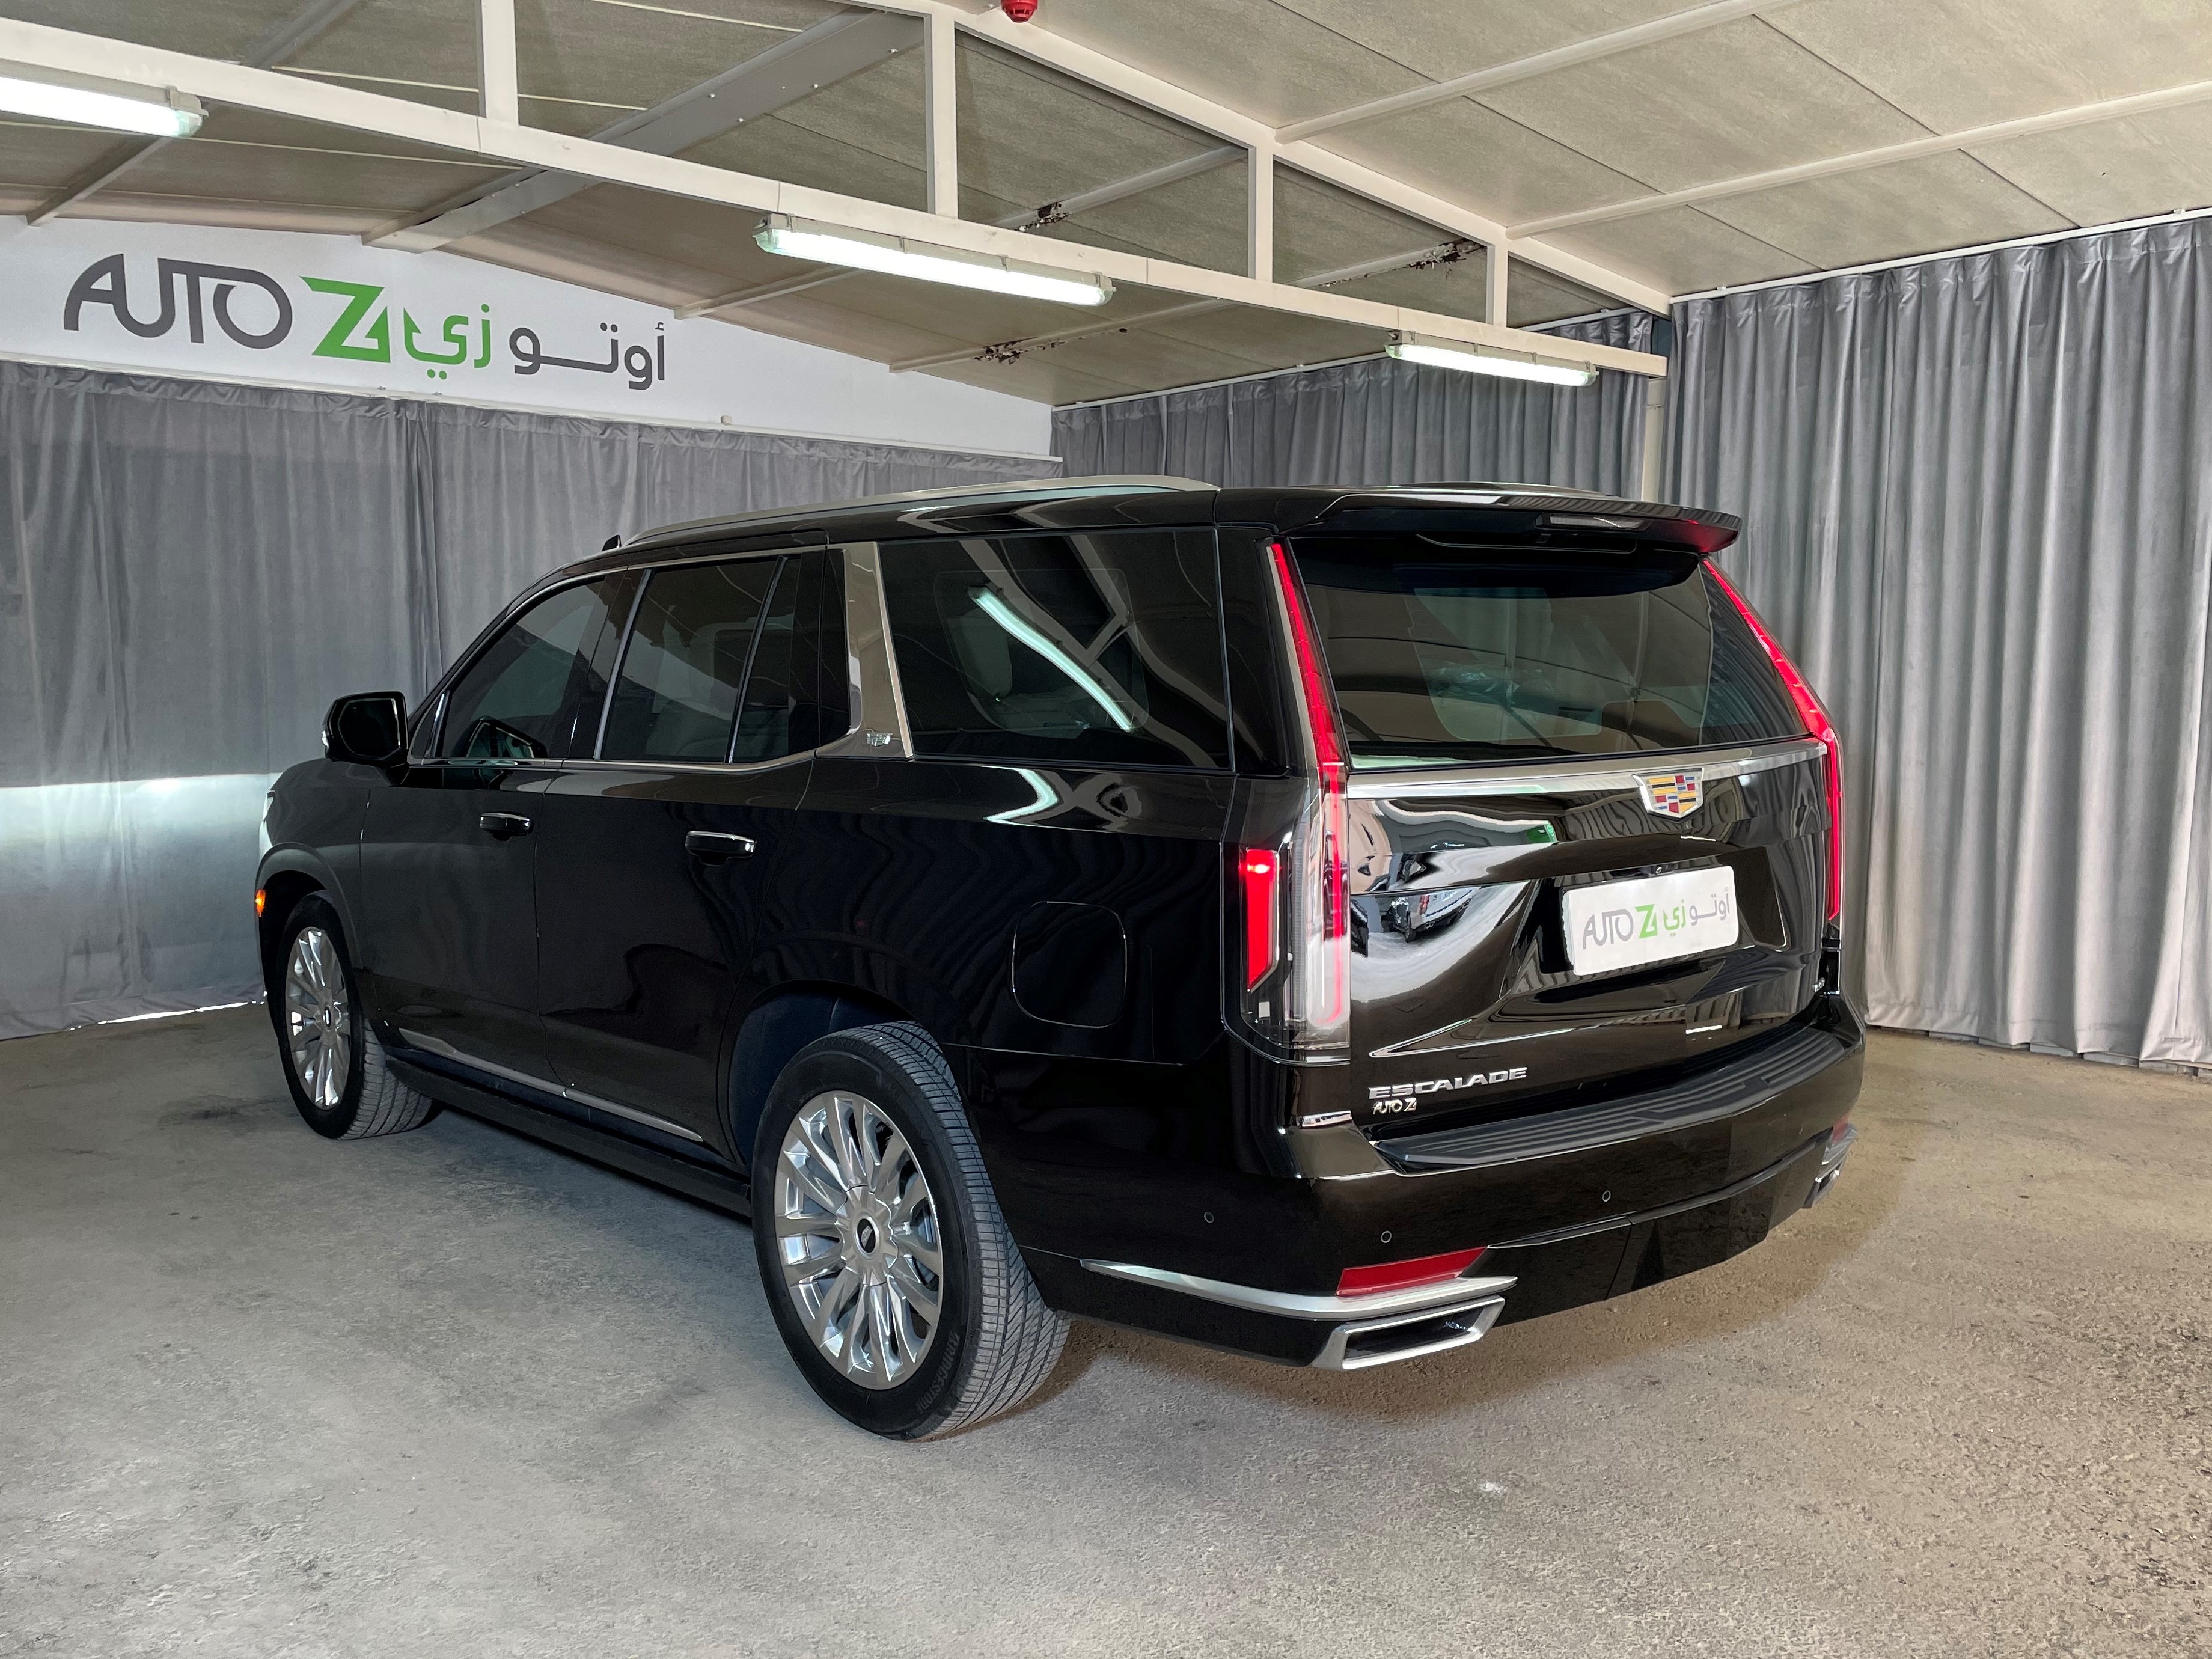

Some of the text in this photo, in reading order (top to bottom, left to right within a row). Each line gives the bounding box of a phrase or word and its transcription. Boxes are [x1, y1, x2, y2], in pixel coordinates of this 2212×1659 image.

[63, 252, 391, 364] AUTO Z
[1583, 904, 1658, 949] AUTO Z
[1368, 1066, 1528, 1099] ESCALADE
[1372, 1099, 1403, 1115] AUTO
